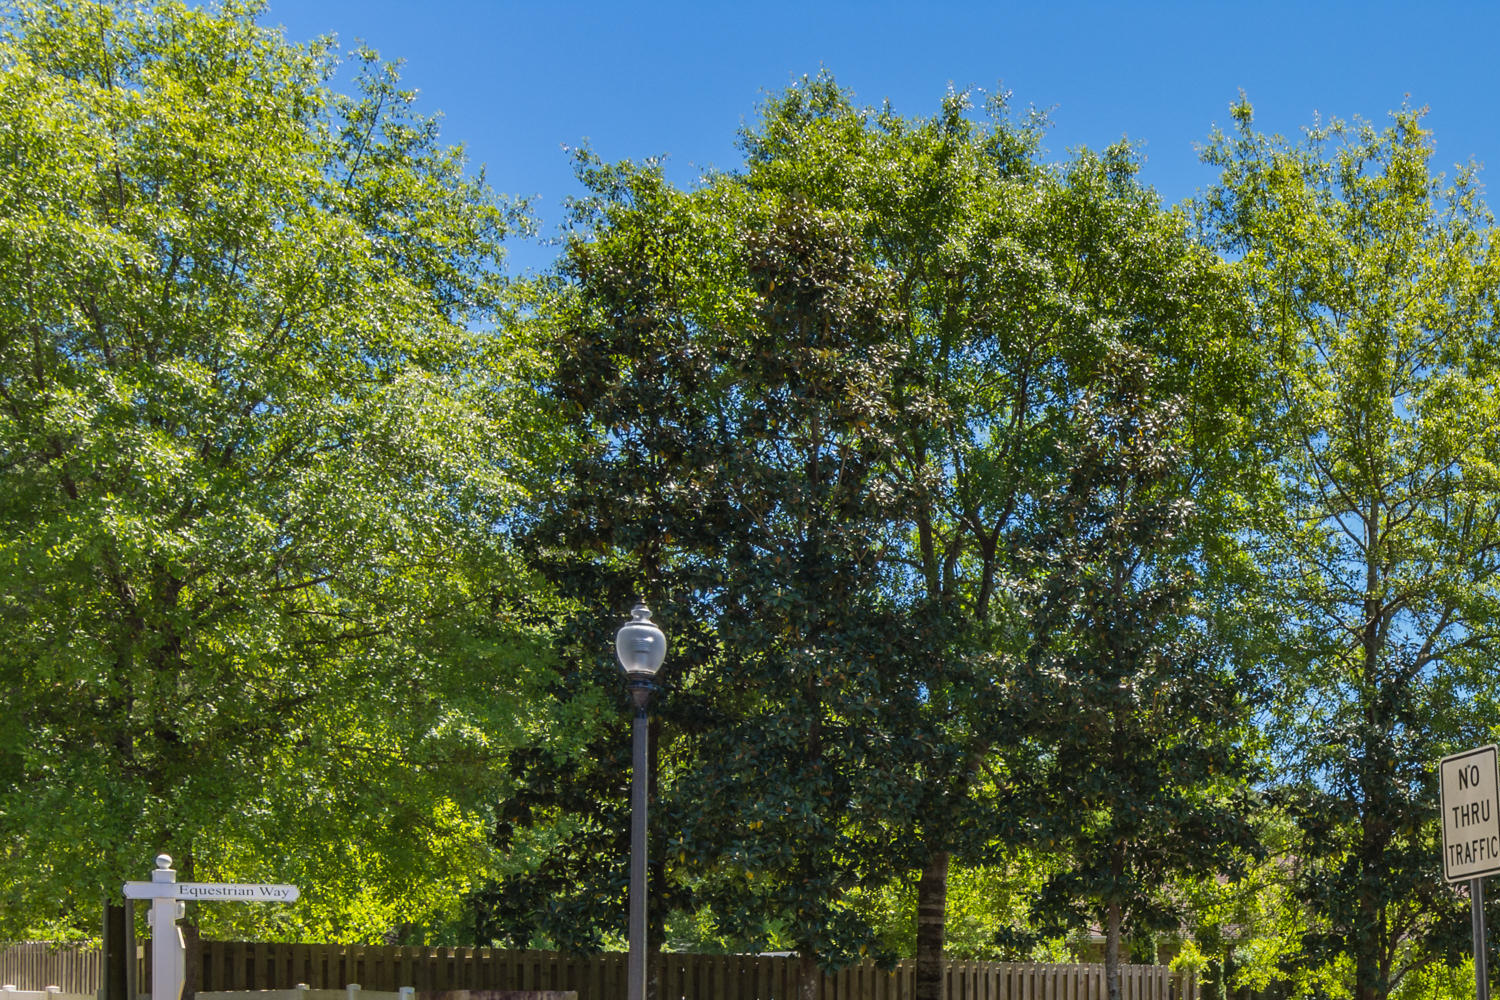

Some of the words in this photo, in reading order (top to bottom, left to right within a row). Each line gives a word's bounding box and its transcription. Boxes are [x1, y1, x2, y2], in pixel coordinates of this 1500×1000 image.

[1458, 765, 1480, 791] NO
[1452, 799, 1490, 829] THRU
[1449, 836, 1499, 867] TRAFFIC
[179, 885, 254, 898] Equestrian
[259, 886, 290, 898] Way
